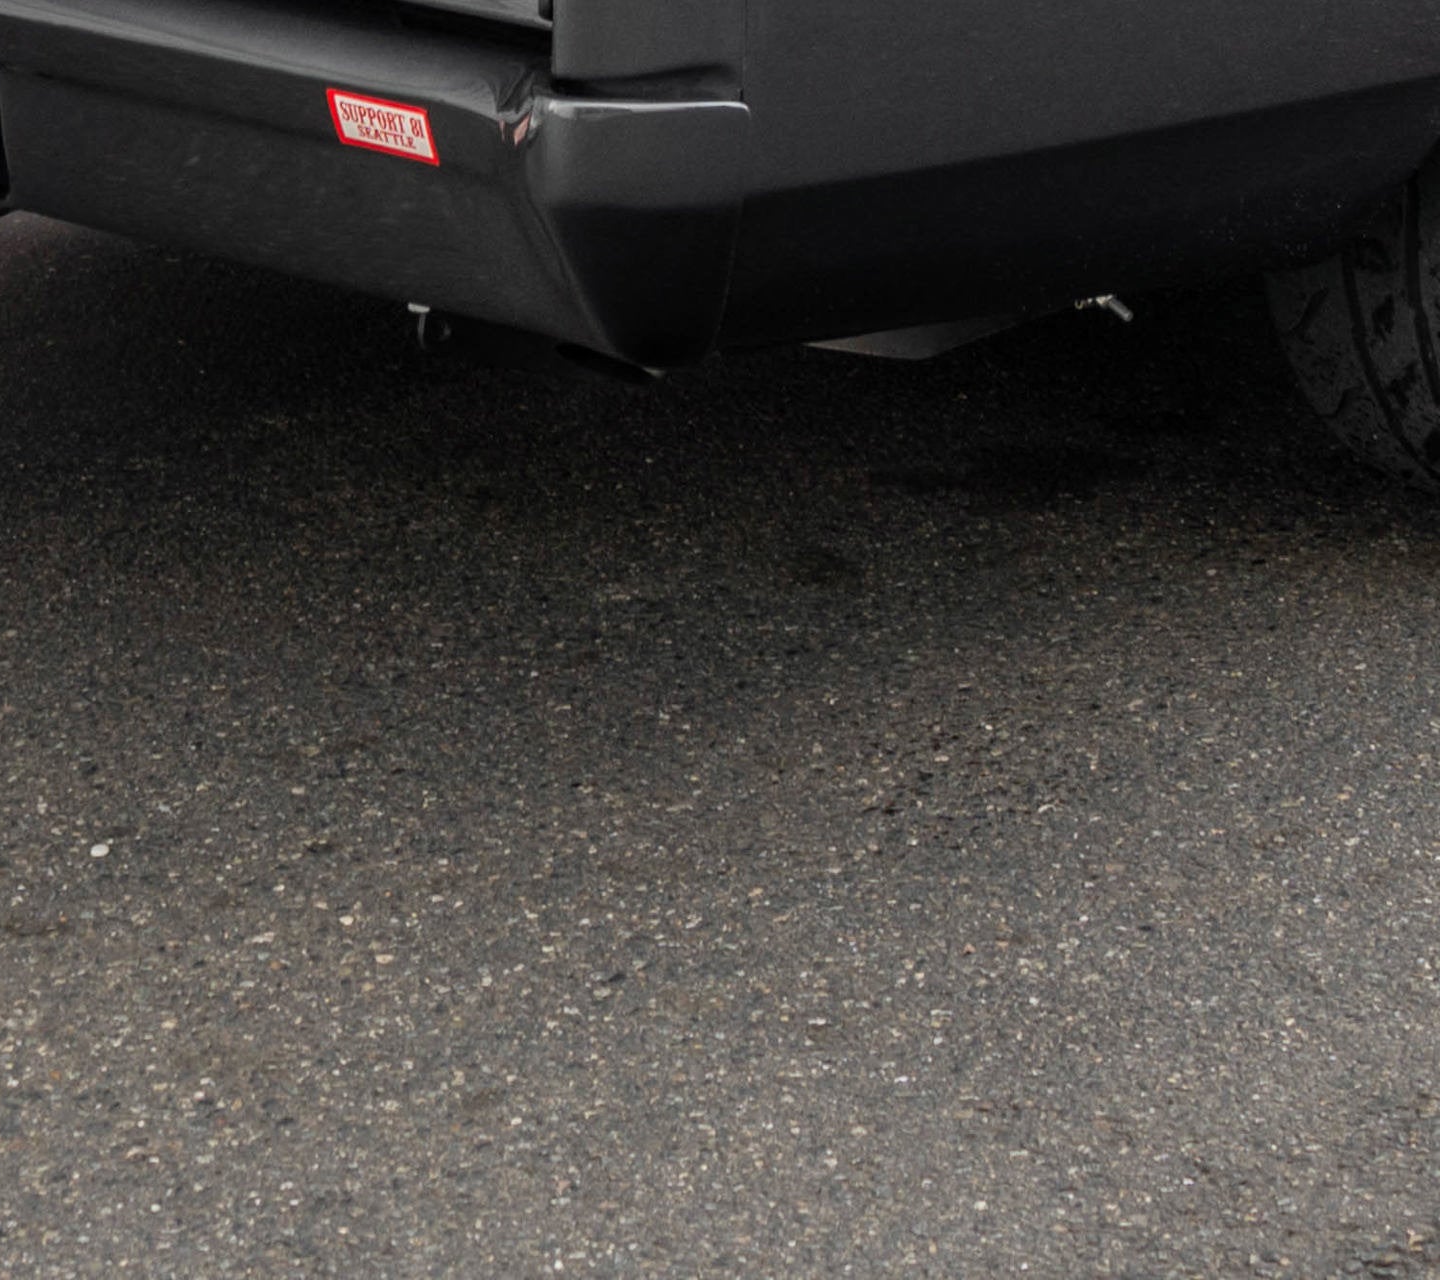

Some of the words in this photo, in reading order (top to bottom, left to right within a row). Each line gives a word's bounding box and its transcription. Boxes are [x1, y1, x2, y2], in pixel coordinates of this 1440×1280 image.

[340, 101, 405, 134] SUPPORT
[409, 117, 425, 139] 81
[357, 124, 417, 150] SEATTLE
